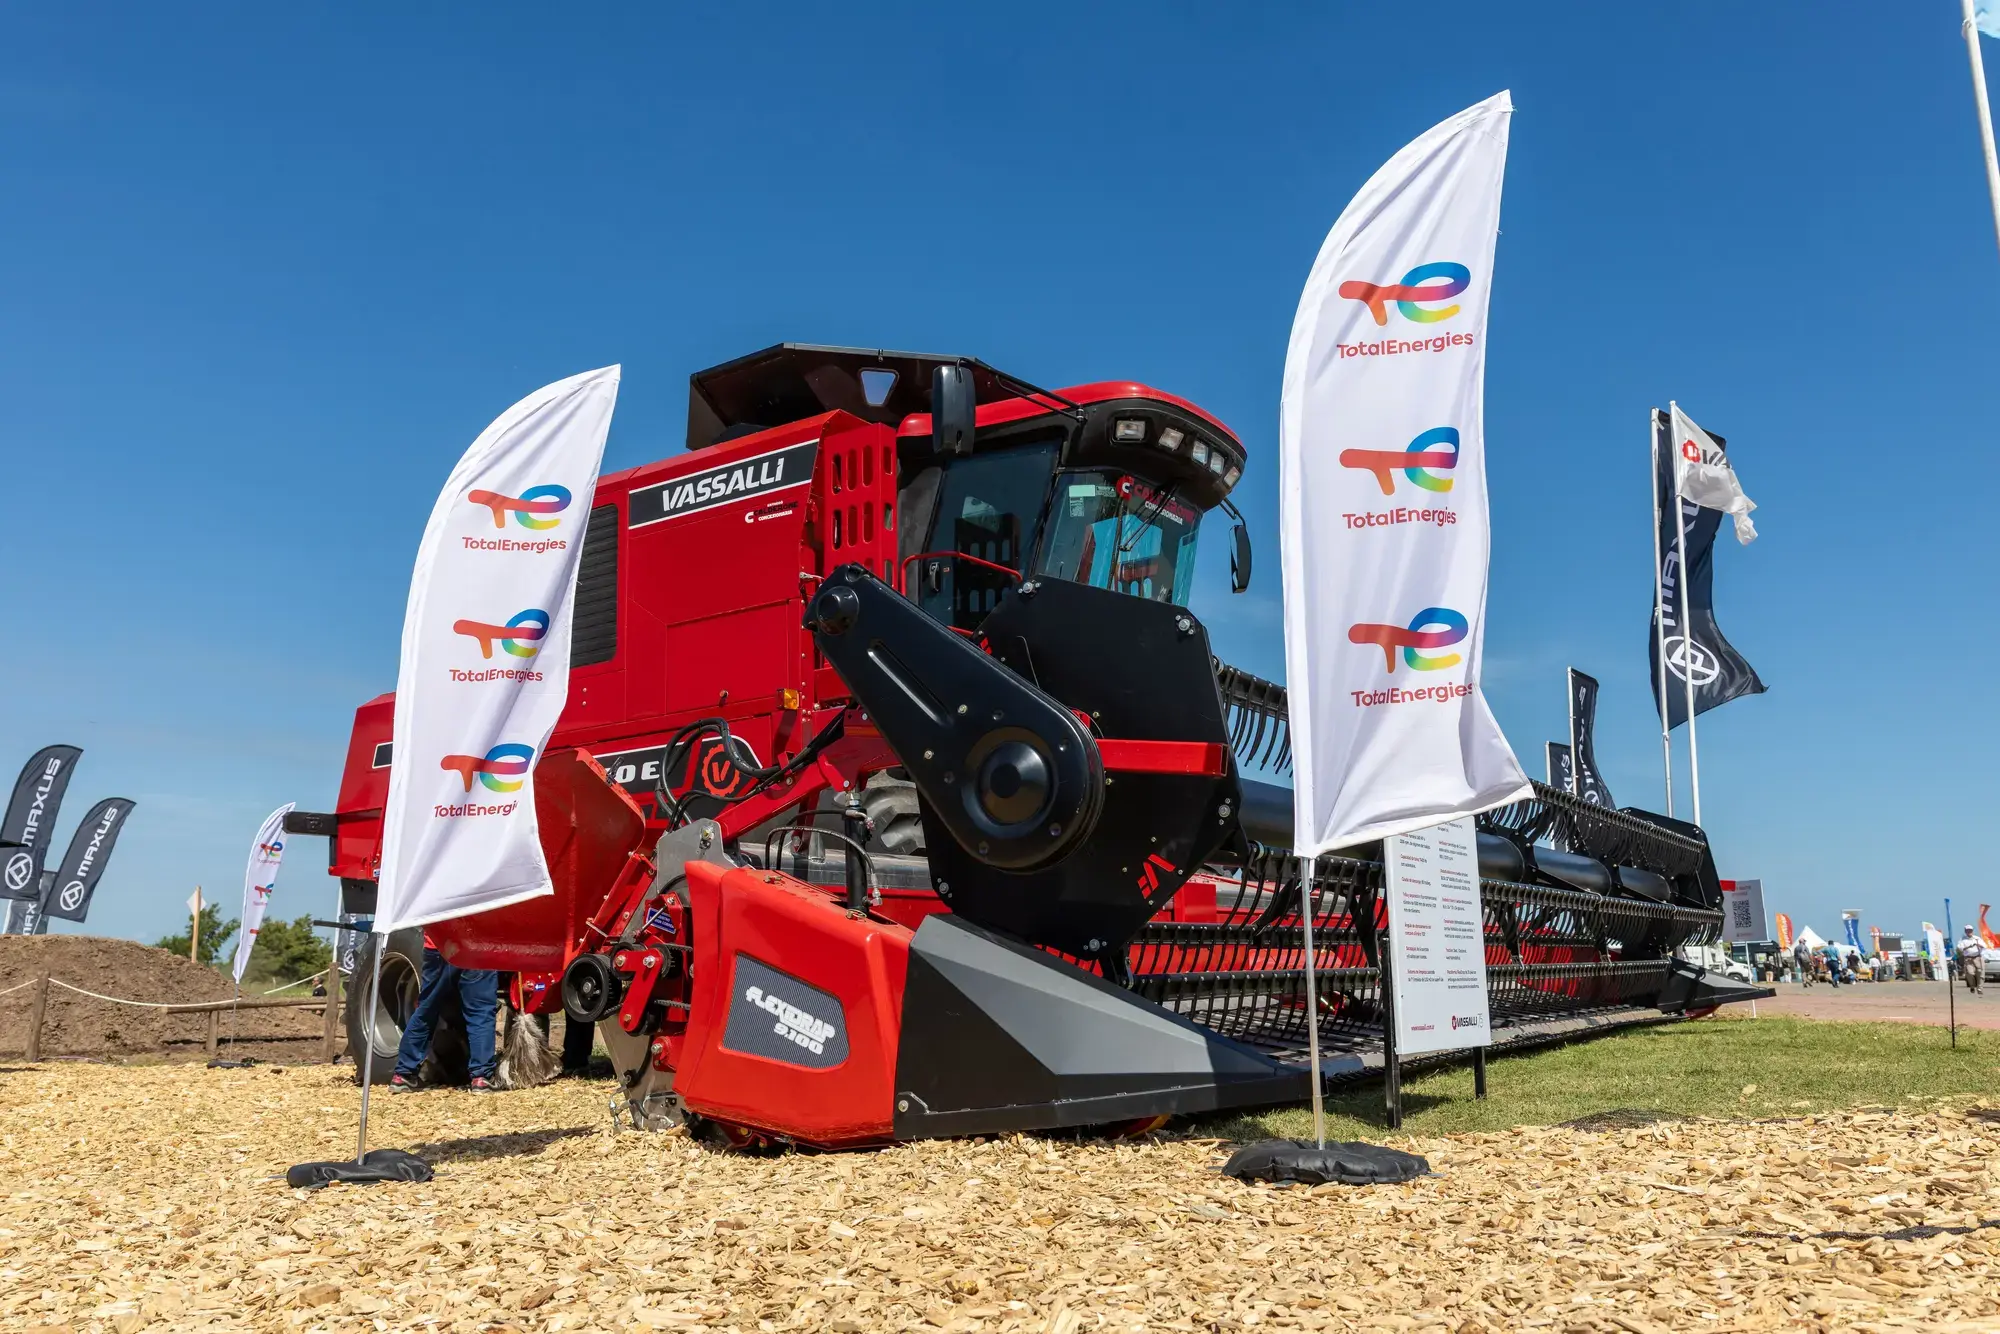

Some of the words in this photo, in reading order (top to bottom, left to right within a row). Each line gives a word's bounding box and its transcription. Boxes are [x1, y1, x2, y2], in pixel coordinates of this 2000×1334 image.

[1336, 332, 1474, 359] TotalEnergies
[662, 457, 785, 512] VASSALLI
[1342, 507, 1457, 529] TotalEnergies
[462, 536, 566, 554] TotalEnergies
[449, 668, 543, 683] TotalEnergies
[21, 757, 61, 847] MAXUS
[434, 801, 518, 818] TotalEnergi
[77, 807, 118, 877] MAXUS
